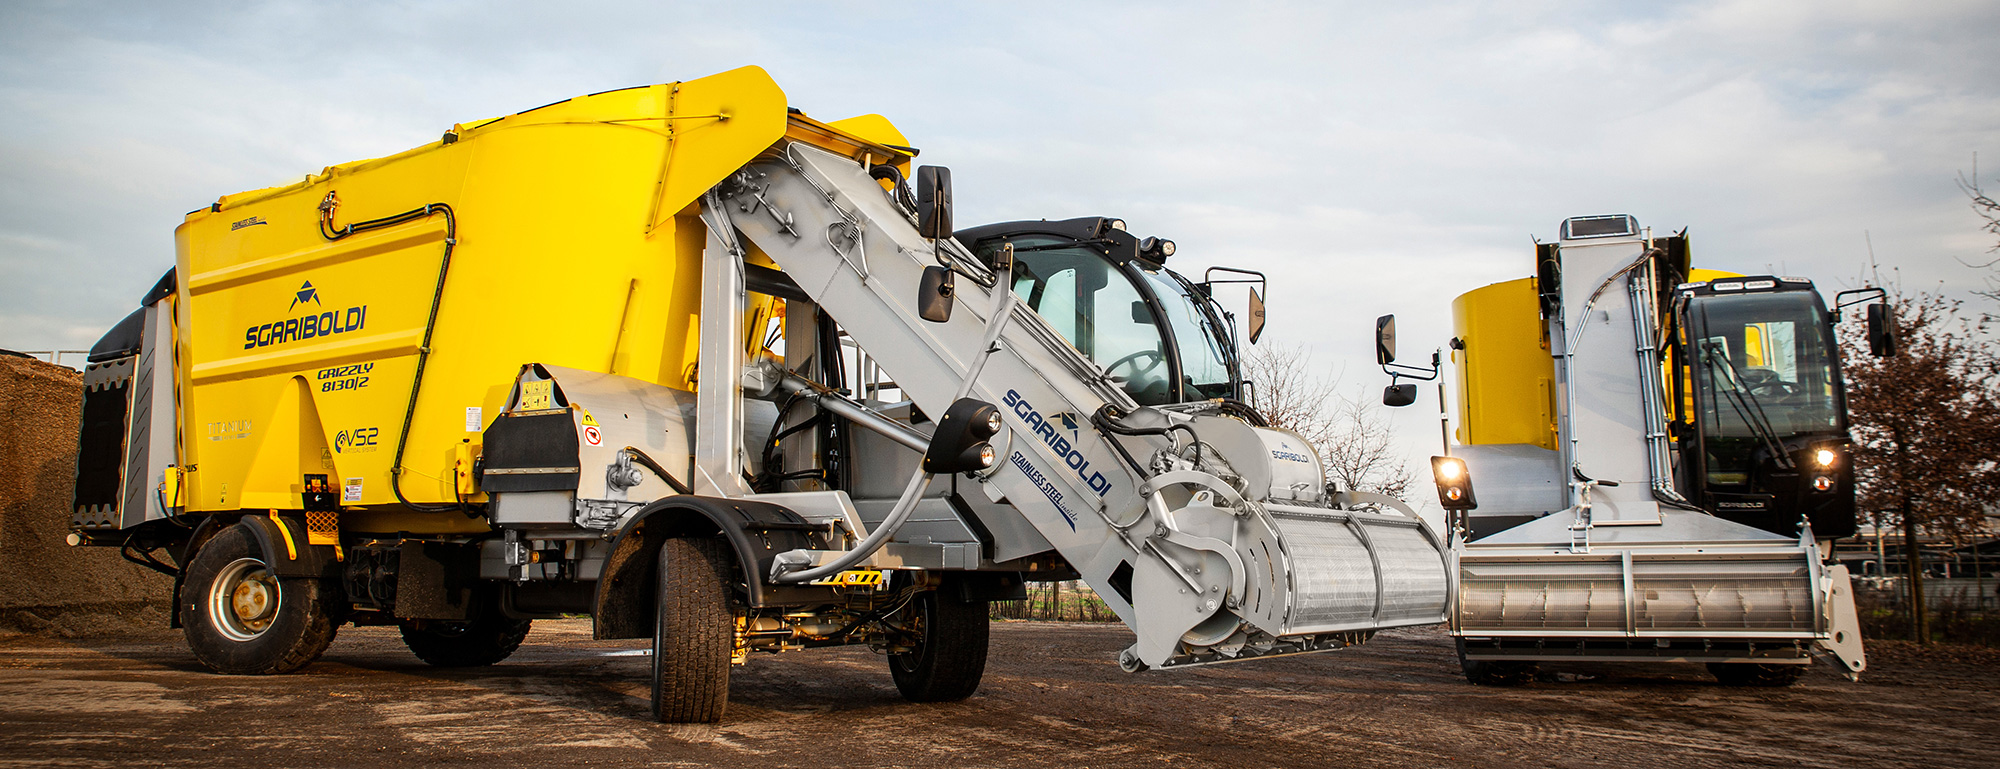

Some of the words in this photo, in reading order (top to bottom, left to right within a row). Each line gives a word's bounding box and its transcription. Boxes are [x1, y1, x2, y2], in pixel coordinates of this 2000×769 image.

[244, 305, 367, 350] SGARIBOLDI
[317, 362, 374, 380] GRIZZLY
[208, 419, 252, 435] TITANIUM
[1002, 389, 1112, 497] SGARIBOLDI
[1011, 451, 1046, 487] STAINLESS
[1042, 482, 1063, 505] STEEL
[1059, 502, 1078, 521] inside
